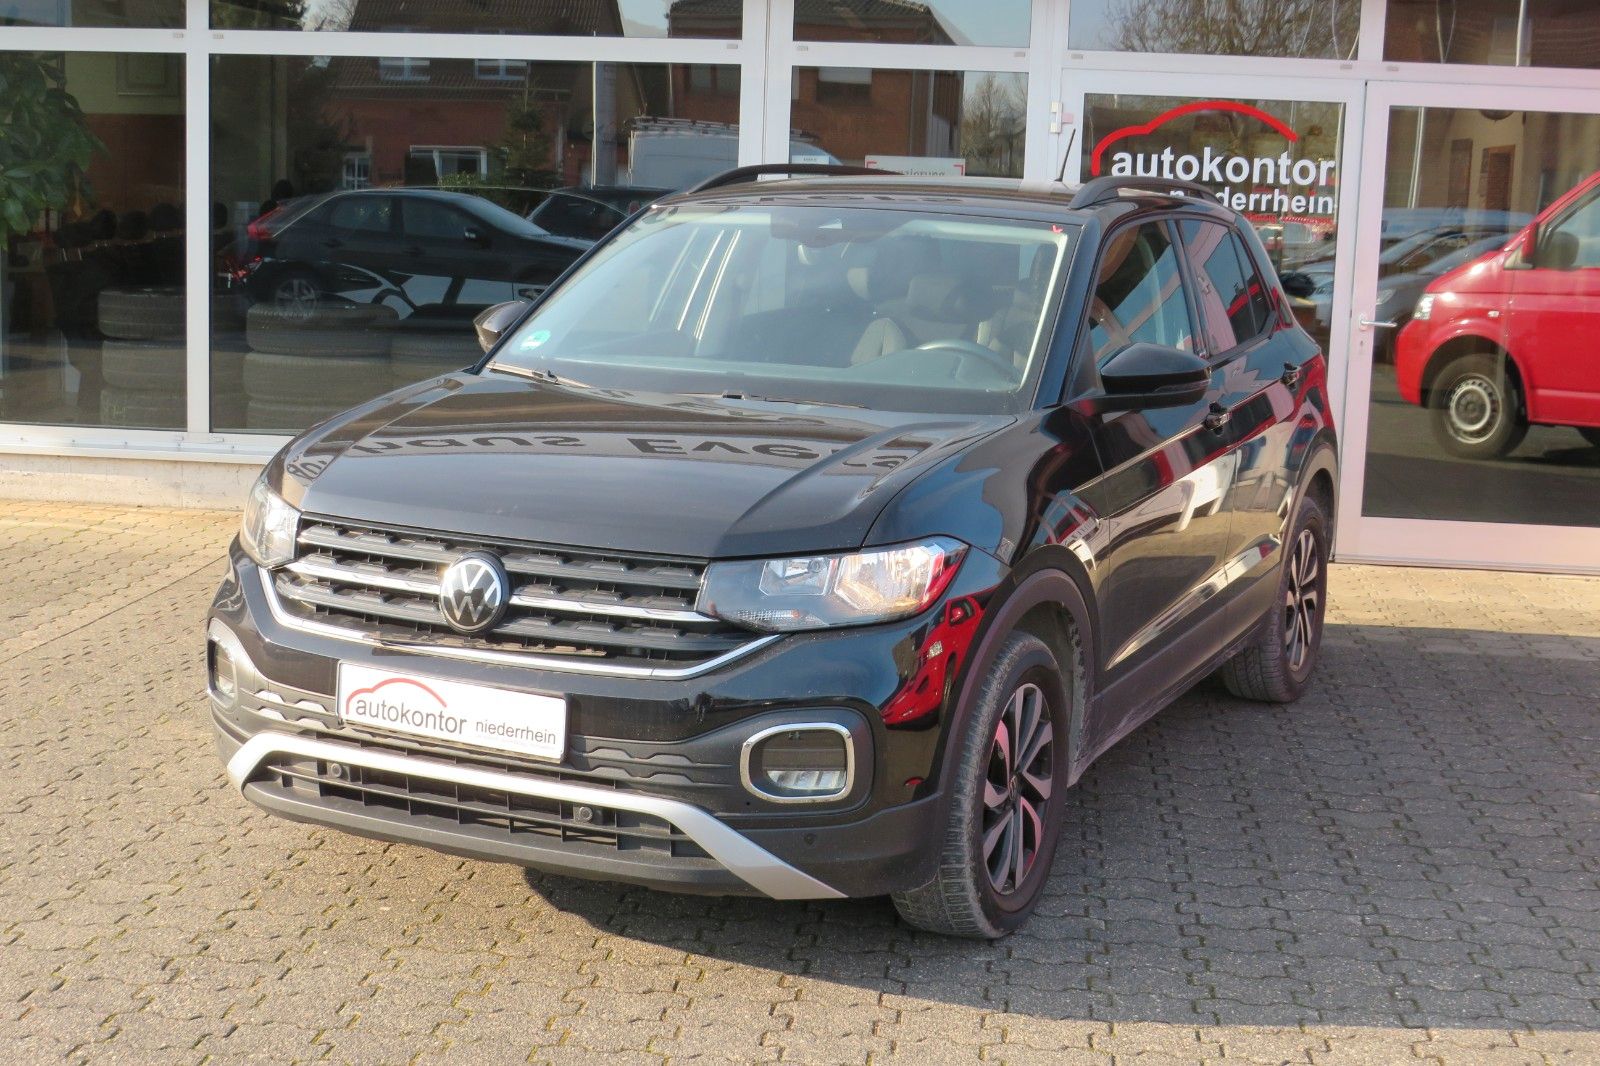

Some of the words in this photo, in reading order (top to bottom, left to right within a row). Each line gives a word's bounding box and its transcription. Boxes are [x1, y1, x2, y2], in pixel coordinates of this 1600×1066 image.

[1110, 146, 1336, 186] autokontor
[1169, 187, 1334, 214] derrhein
[355, 699, 467, 735] autokontor
[475, 719, 556, 745] niederrhein
